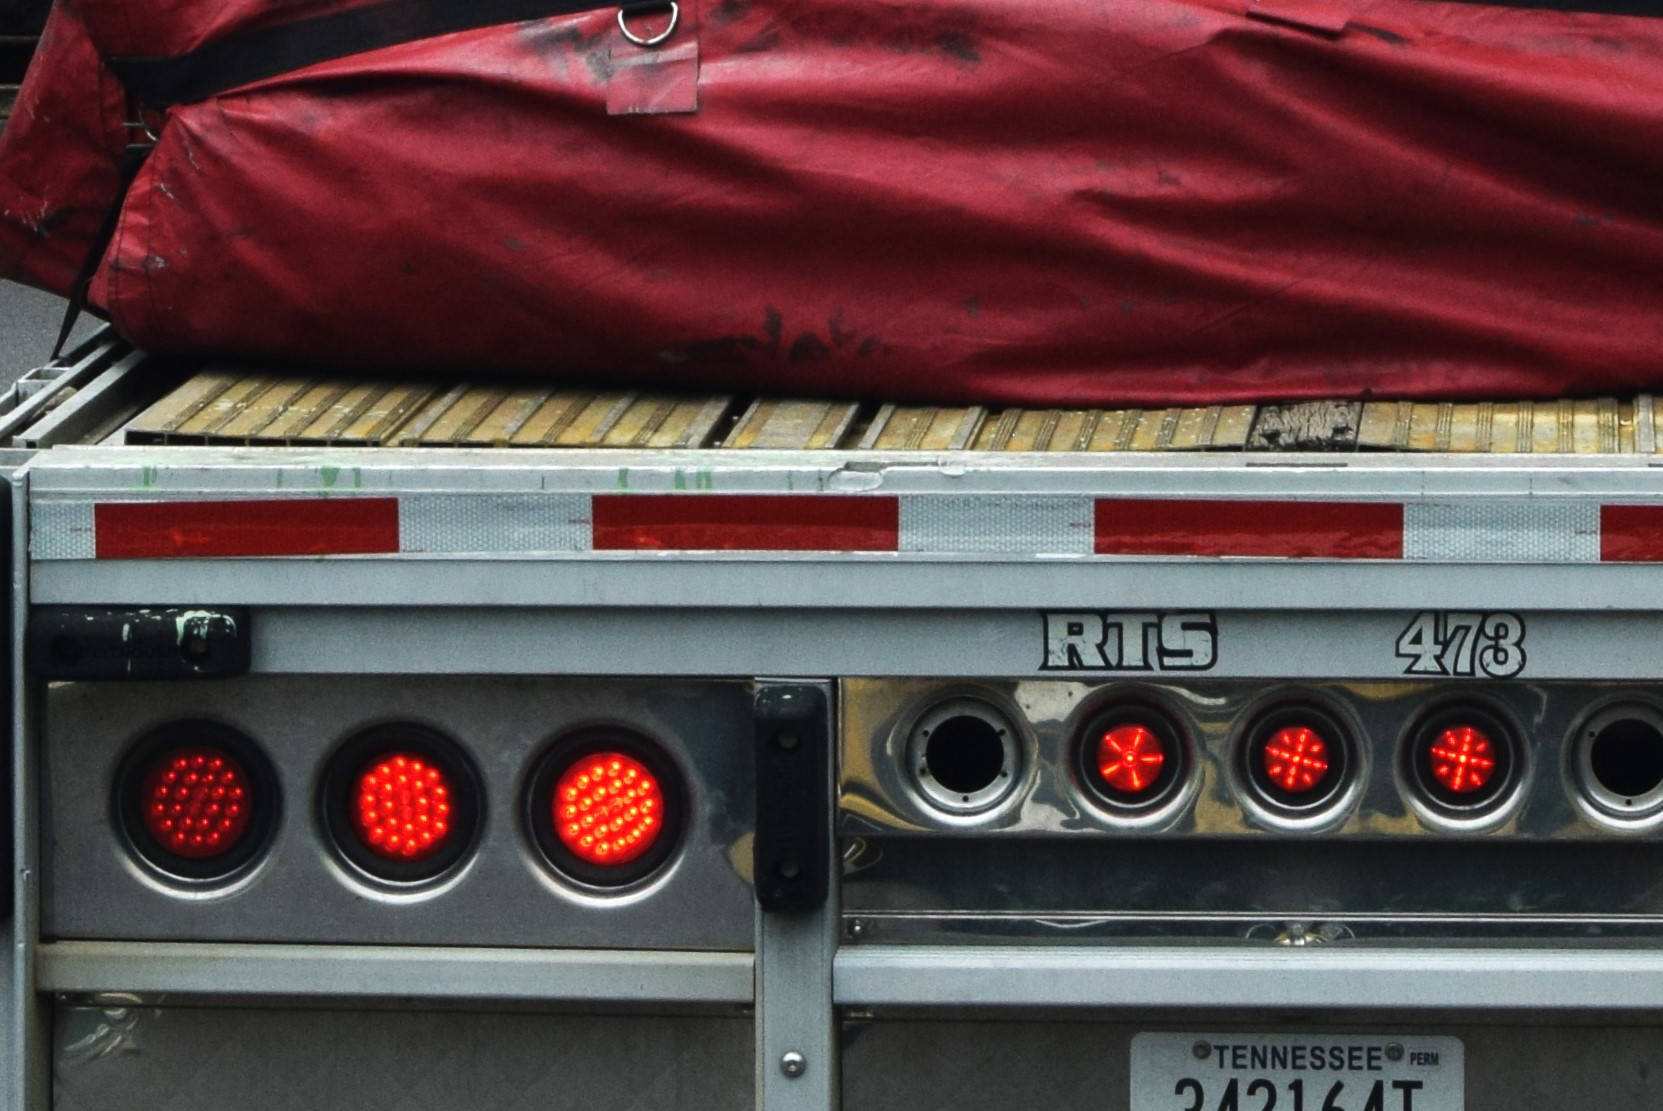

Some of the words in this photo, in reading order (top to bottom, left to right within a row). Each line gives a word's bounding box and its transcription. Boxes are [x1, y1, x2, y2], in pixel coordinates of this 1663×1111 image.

[1038, 609, 1218, 671] RTS
[1395, 610, 1527, 678] 473
[1213, 1044, 1383, 1071] TENNESSEE
[1409, 1051, 1440, 1066] PERM
